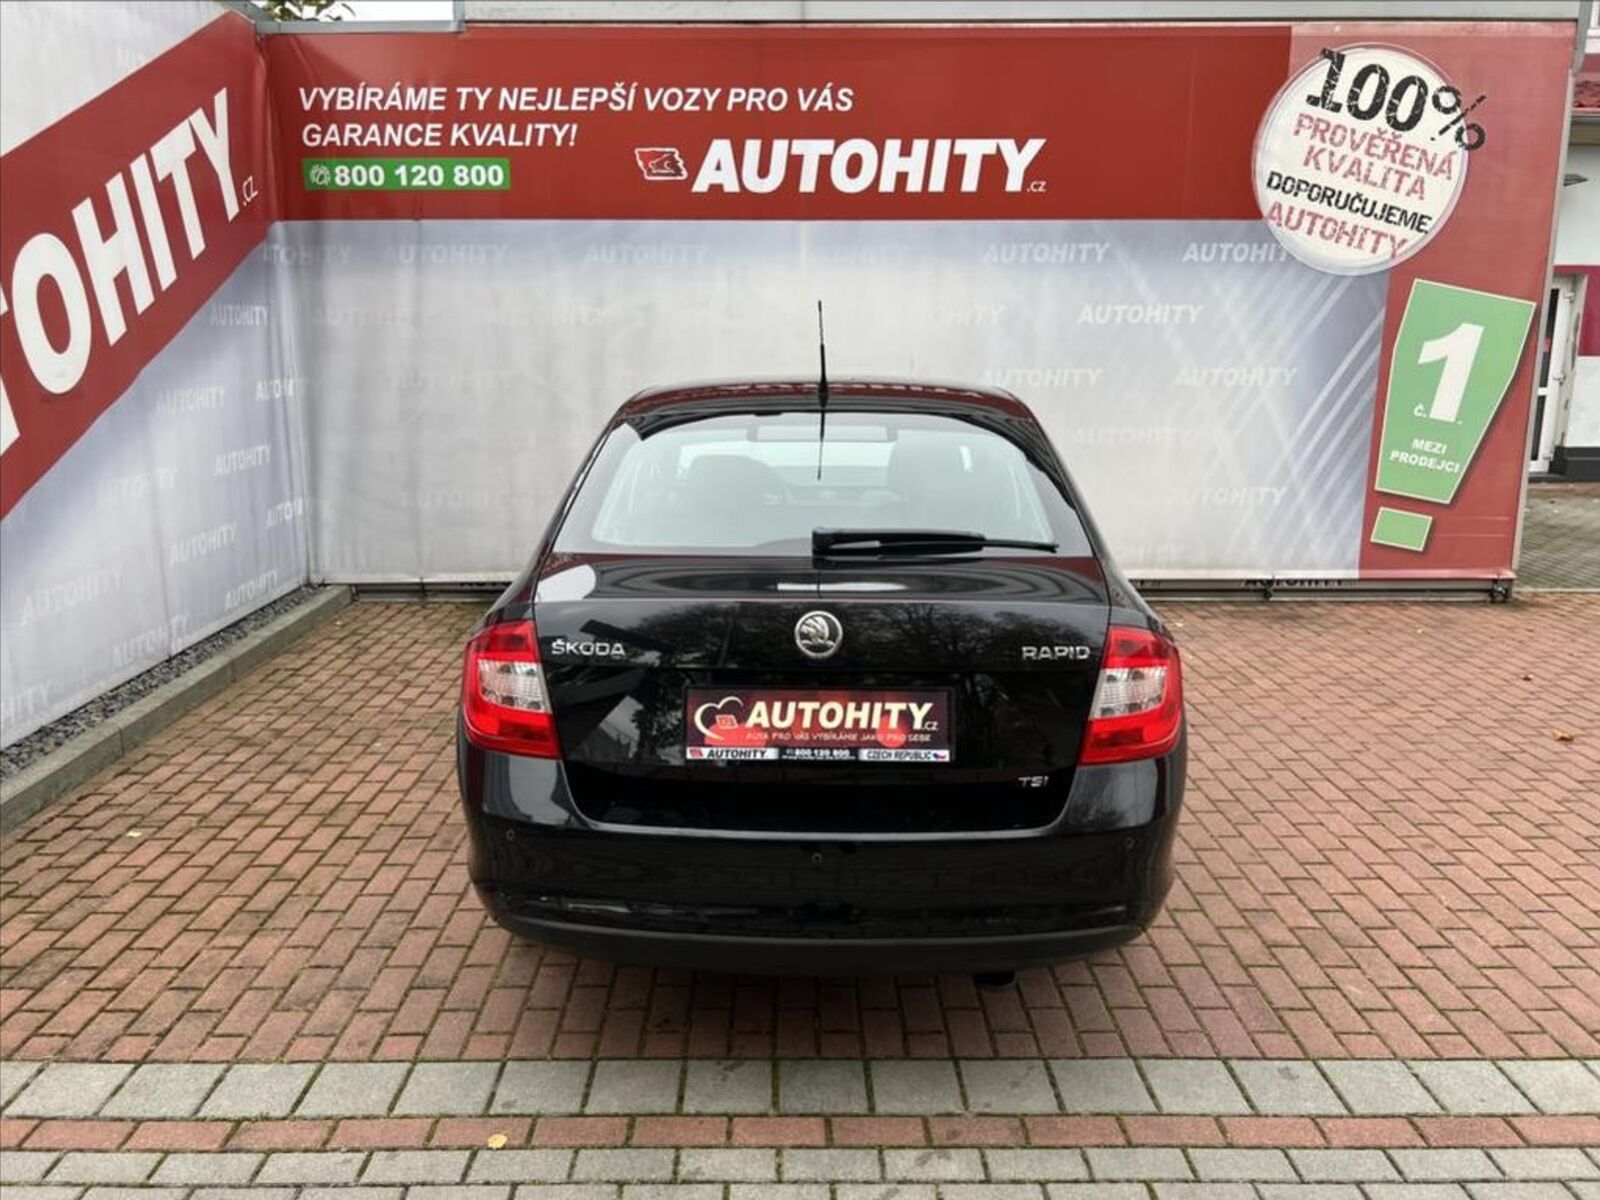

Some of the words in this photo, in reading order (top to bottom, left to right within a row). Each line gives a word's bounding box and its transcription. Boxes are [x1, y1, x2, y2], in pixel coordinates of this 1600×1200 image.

[299, 81, 447, 111] VYBÍRÁME
[456, 87, 492, 110] TY
[498, 82, 638, 111] NEJLEPŠÍ
[643, 87, 721, 111] VOZY
[727, 87, 788, 111] PRO
[797, 82, 854, 111] VÁS
[1306, 48, 1487, 150] 100%
[302, 123, 442, 147] GARANCE
[450, 123, 578, 147] KVALITY!
[1293, 113, 1457, 181] PROVĚŘENÁ
[334, 164, 385, 186] 800
[394, 164, 444, 186] 120
[453, 164, 504, 186] 800
[1303, 145, 1426, 201] KVALITA
[1266, 171, 1432, 235] DOPORUČUJEME
[1268, 201, 1408, 259] AUTOHITY
[983, 242, 1110, 263] AUTOHITY
[211, 303, 269, 326] AUTOHITY
[1077, 304, 1203, 325] AUTOHITY
[1175, 367, 1298, 387] AUTOHITY
[1412, 438, 1447, 454] MEZI
[214, 444, 271, 477] AUTOHITY
[1389, 450, 1460, 473] PRODEJCI
[169, 521, 237, 568] AUTOHITY
[551, 638, 626, 656] ŠKODA
[1022, 645, 1091, 660] RAPID
[772, 732, 792, 741] PRO
[908, 733, 931, 742] SEBE
[707, 749, 768, 760] AUTOHITY
[866, 751, 893, 761] CZECH
[894, 751, 931, 761] REPUBLIC
[1018, 776, 1048, 788] TSI
